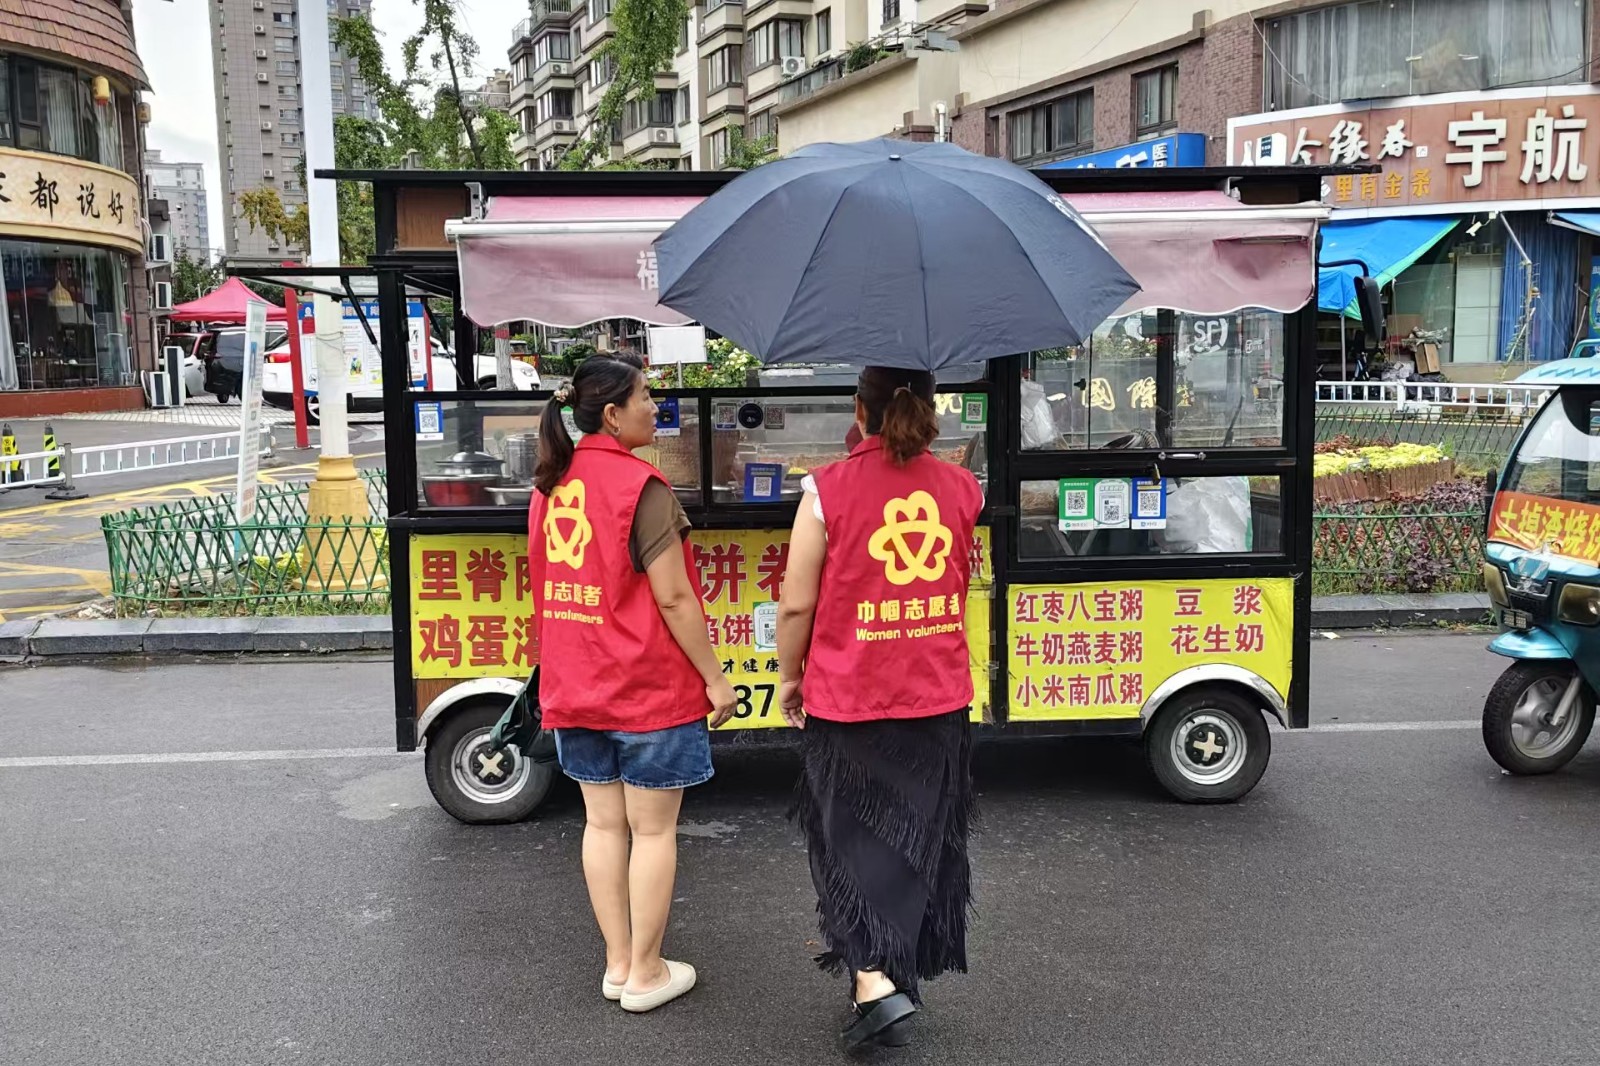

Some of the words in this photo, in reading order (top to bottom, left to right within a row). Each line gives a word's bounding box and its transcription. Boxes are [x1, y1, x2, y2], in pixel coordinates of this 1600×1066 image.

[1445, 104, 1588, 188] 宇航
[1335, 168, 1431, 202] 里有金条
[857, 593, 960, 624] 巾帼志愿者
[1015, 588, 1143, 625] 红枣八宝粥
[856, 628, 901, 642] Women
[906, 621, 963, 639] volunteers
[1015, 630, 1143, 667] 牛奶燕麦粥
[1171, 623, 1264, 655] 花生奶
[722, 658, 779, 674] 才健康
[1015, 672, 1143, 708] 小米南瓜粥
